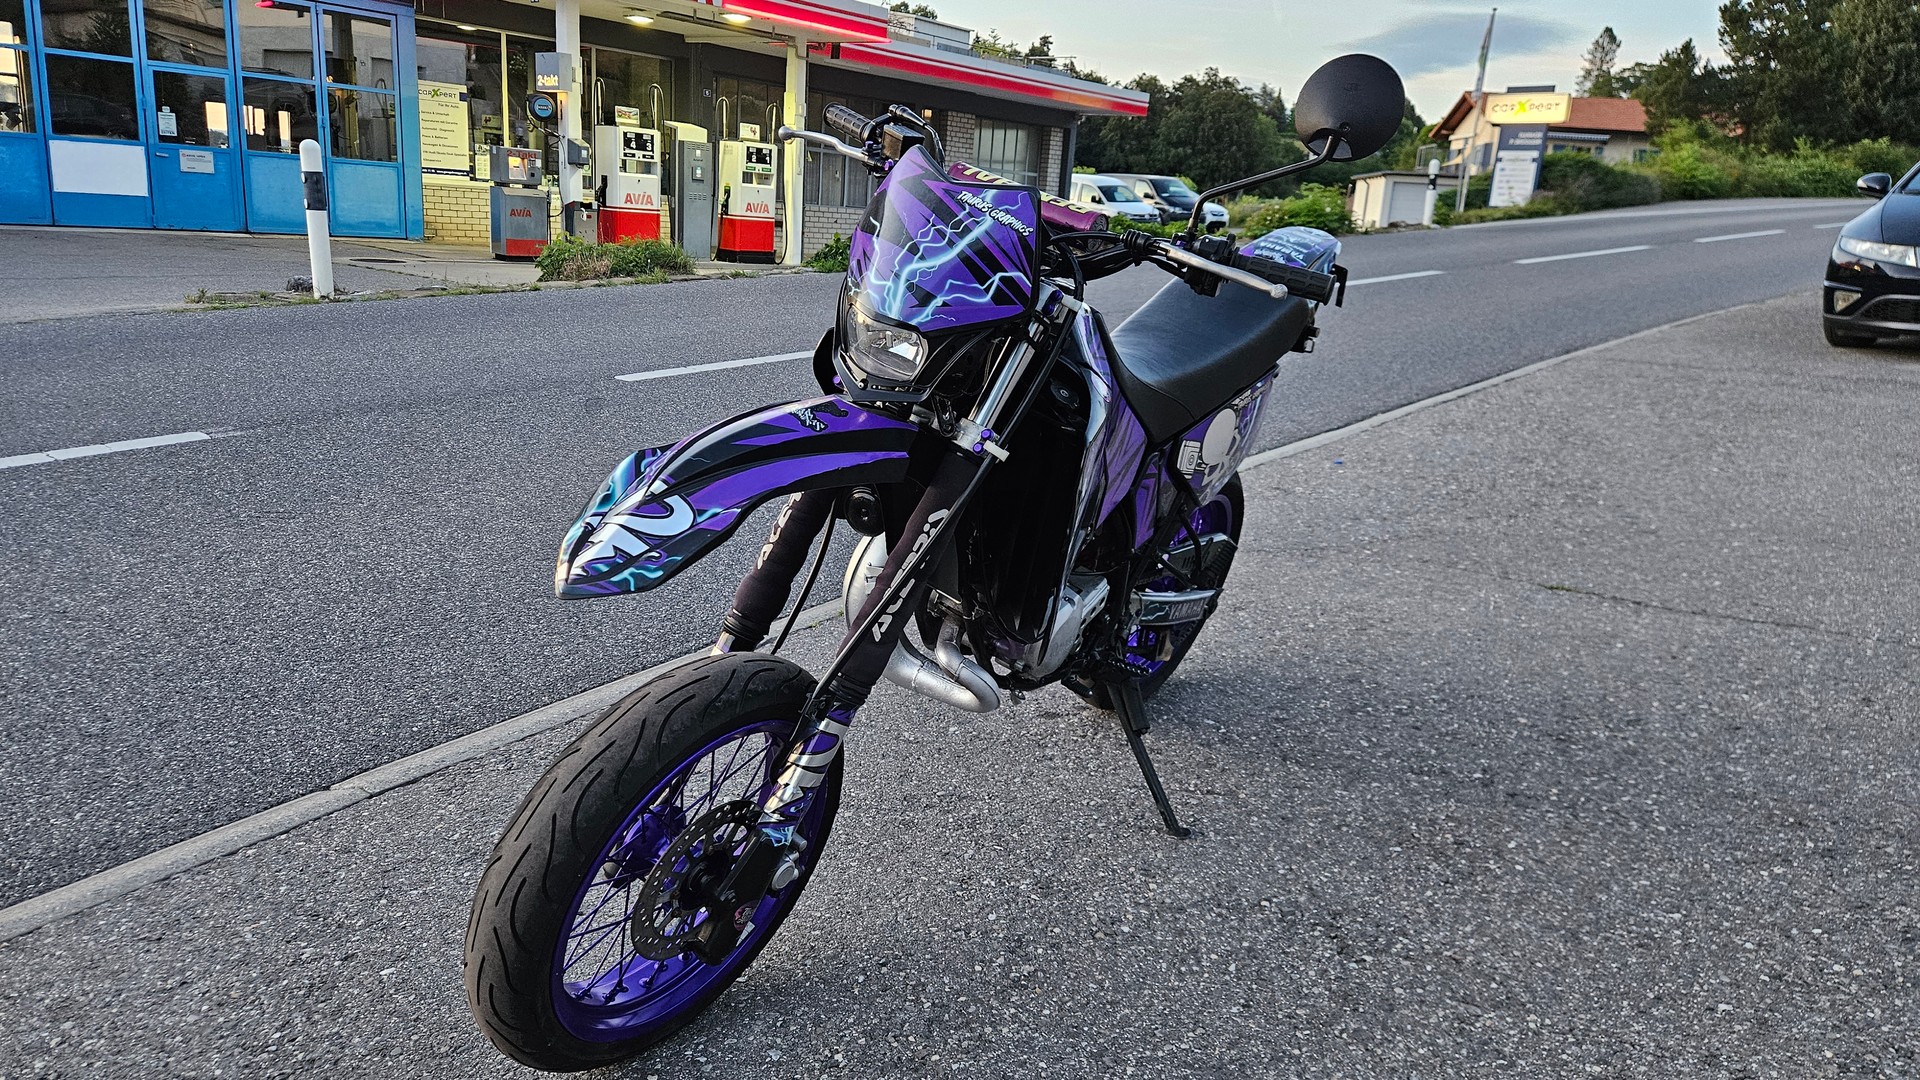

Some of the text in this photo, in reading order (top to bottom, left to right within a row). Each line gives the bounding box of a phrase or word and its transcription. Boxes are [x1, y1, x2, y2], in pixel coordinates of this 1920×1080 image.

[630, 141, 652, 151] 4 3
[624, 191, 654, 206] AVIA
[509, 207, 532, 218] AVIA
[745, 201, 770, 214] AVIA
[957, 190, 1034, 236] TAURUS GRAPHICS
